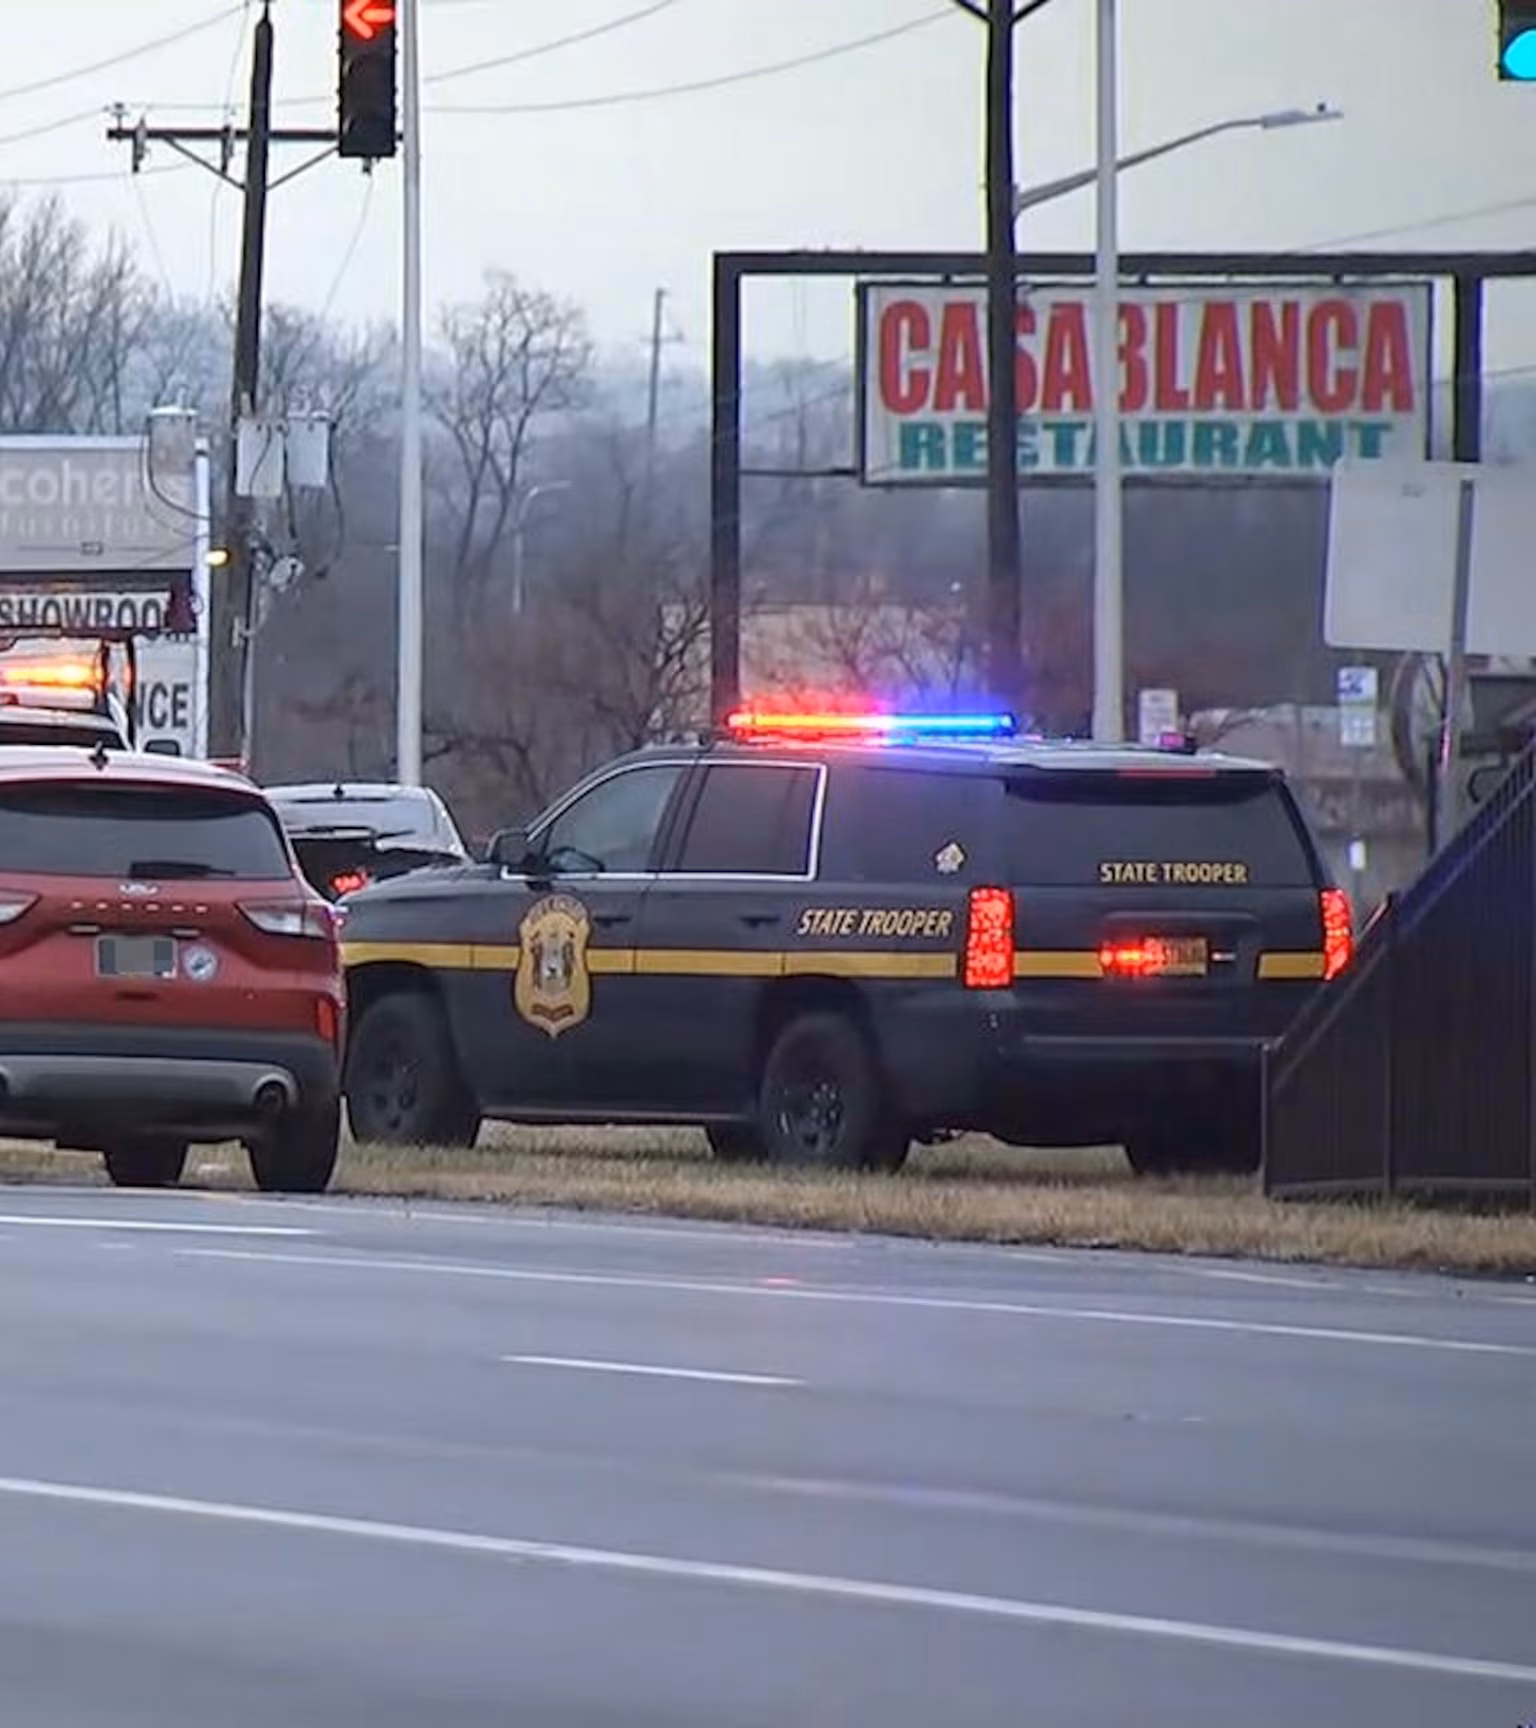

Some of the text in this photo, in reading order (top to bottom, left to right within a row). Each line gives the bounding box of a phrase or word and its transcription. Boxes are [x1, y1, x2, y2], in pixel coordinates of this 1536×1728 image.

[1101, 862, 1248, 883] STATE TROOPER
[798, 908, 953, 937] STATE TROOPER
